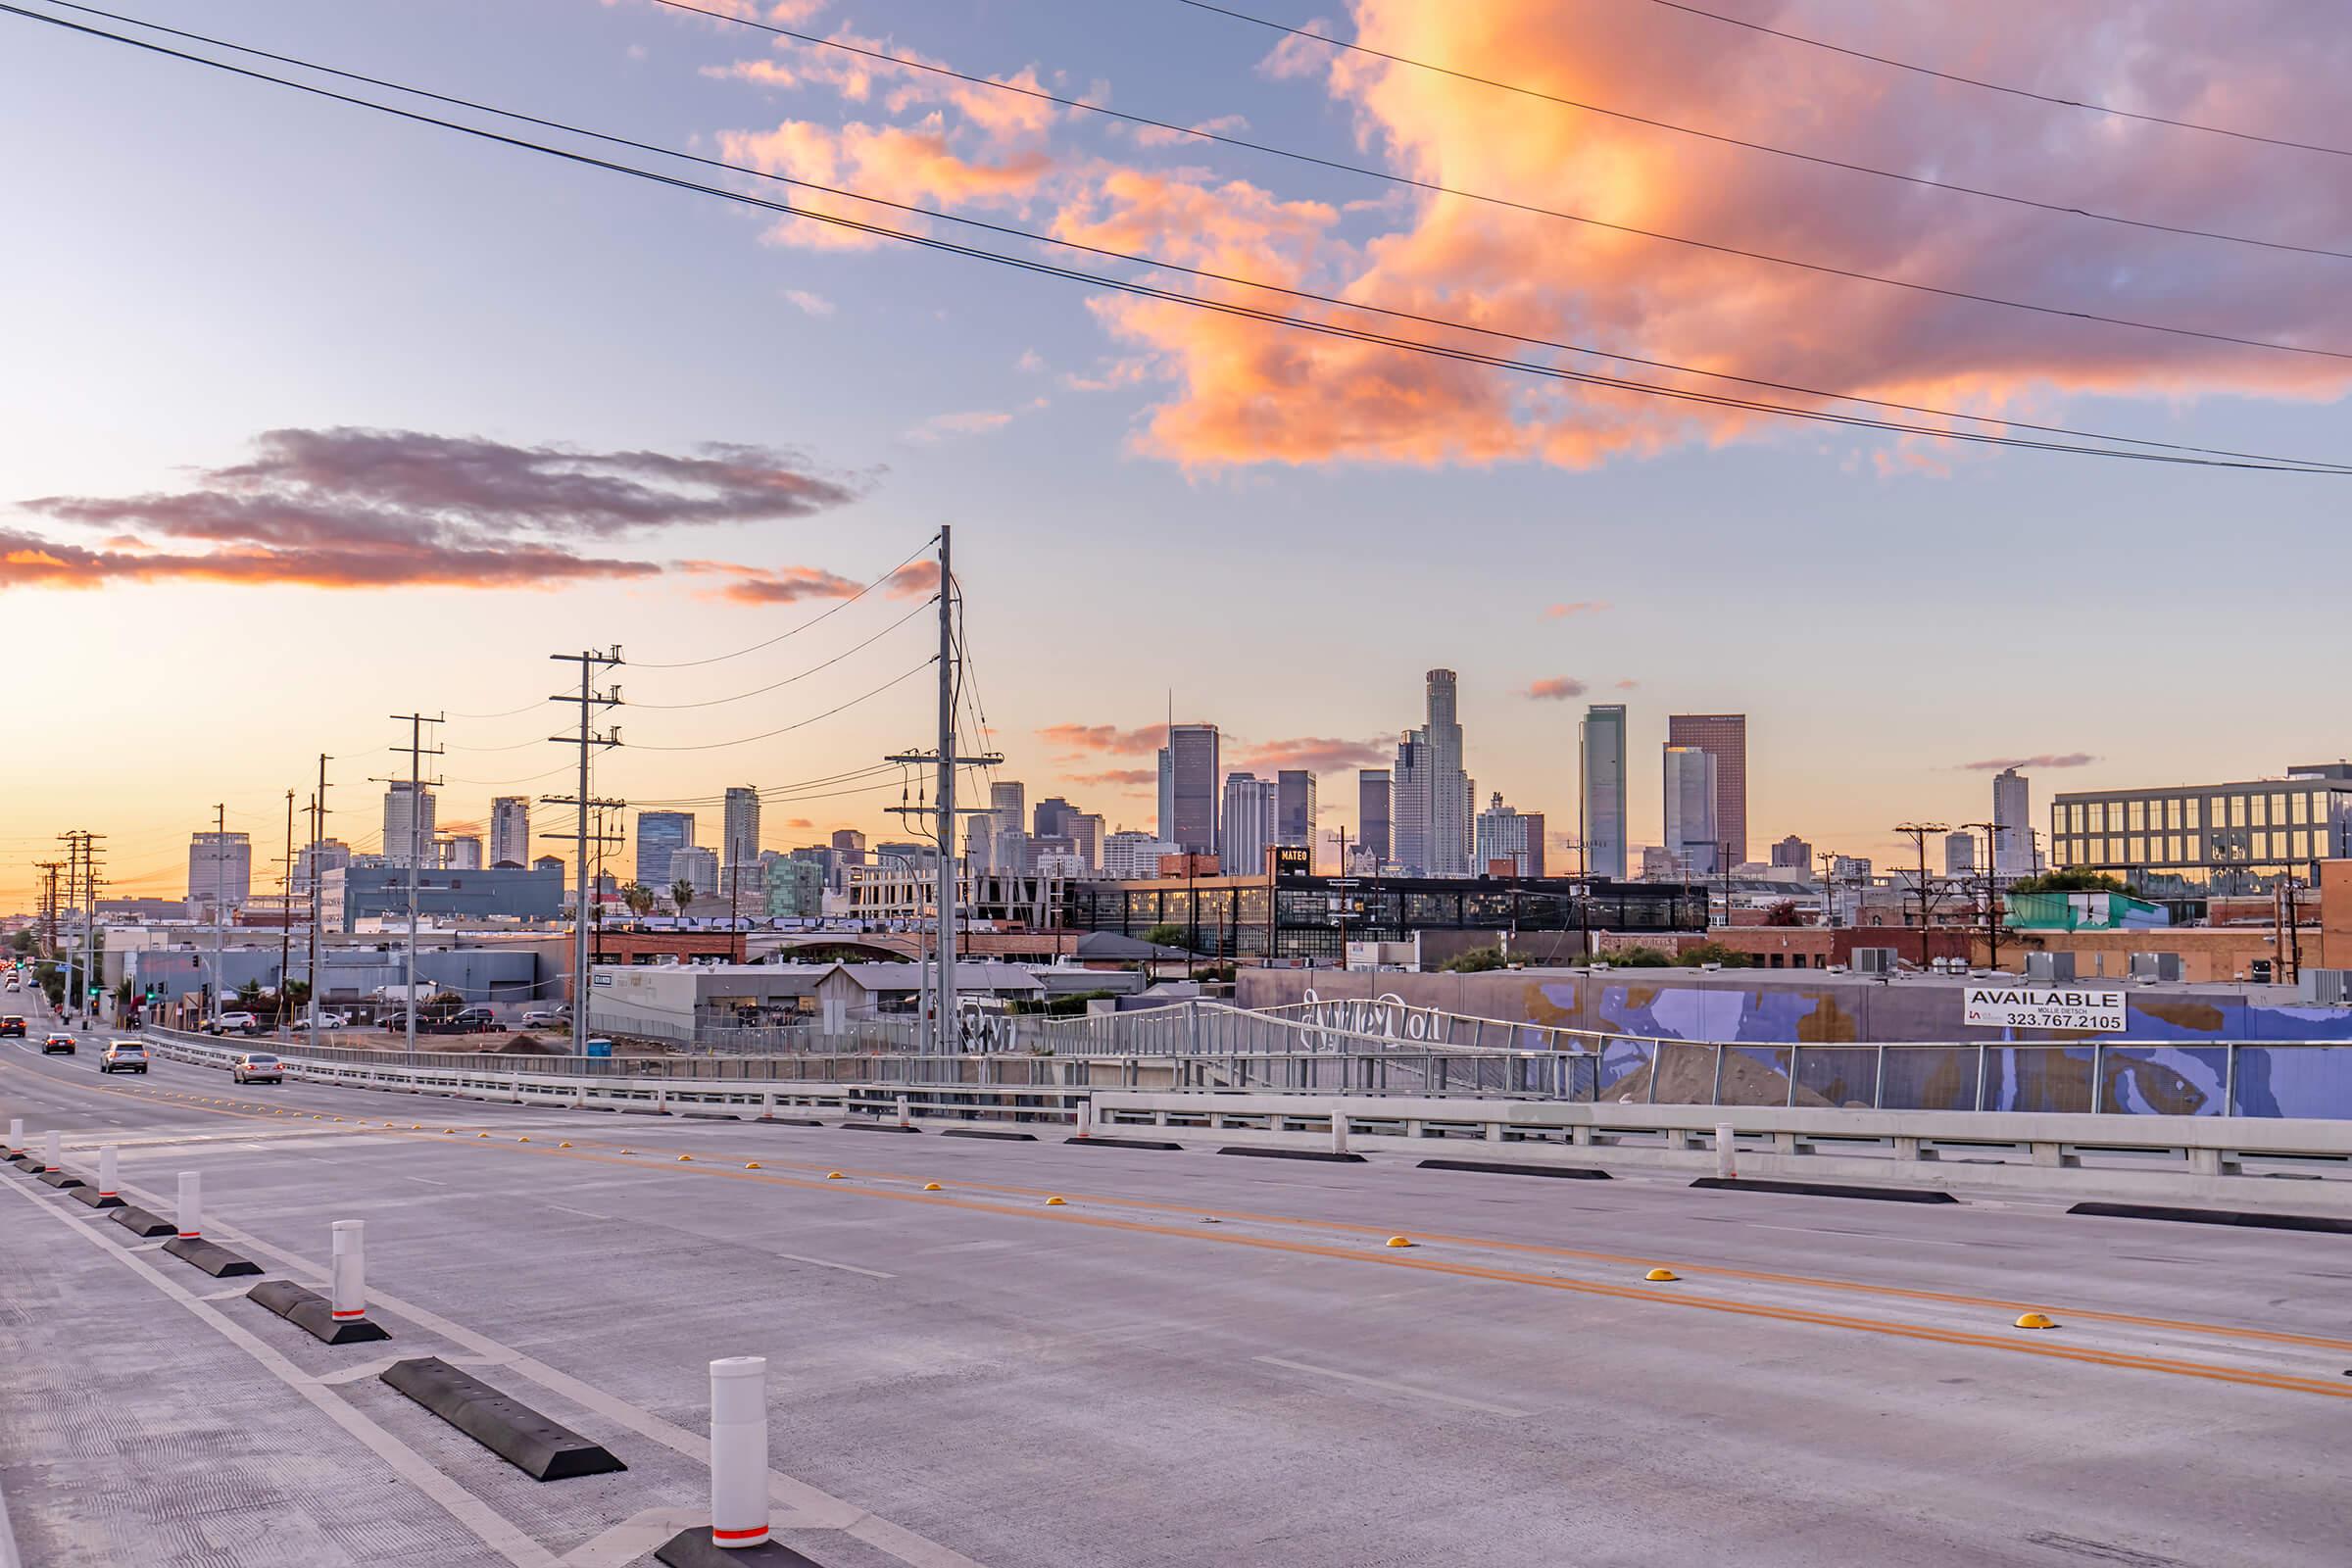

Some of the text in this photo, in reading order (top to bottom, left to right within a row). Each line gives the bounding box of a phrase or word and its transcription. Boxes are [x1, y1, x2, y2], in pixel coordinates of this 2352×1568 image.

[1281, 850, 1307, 861] MATEO
[1971, 990, 2119, 1007] AVAILABLE
[2007, 1012, 2121, 1029] 323.767.2105
